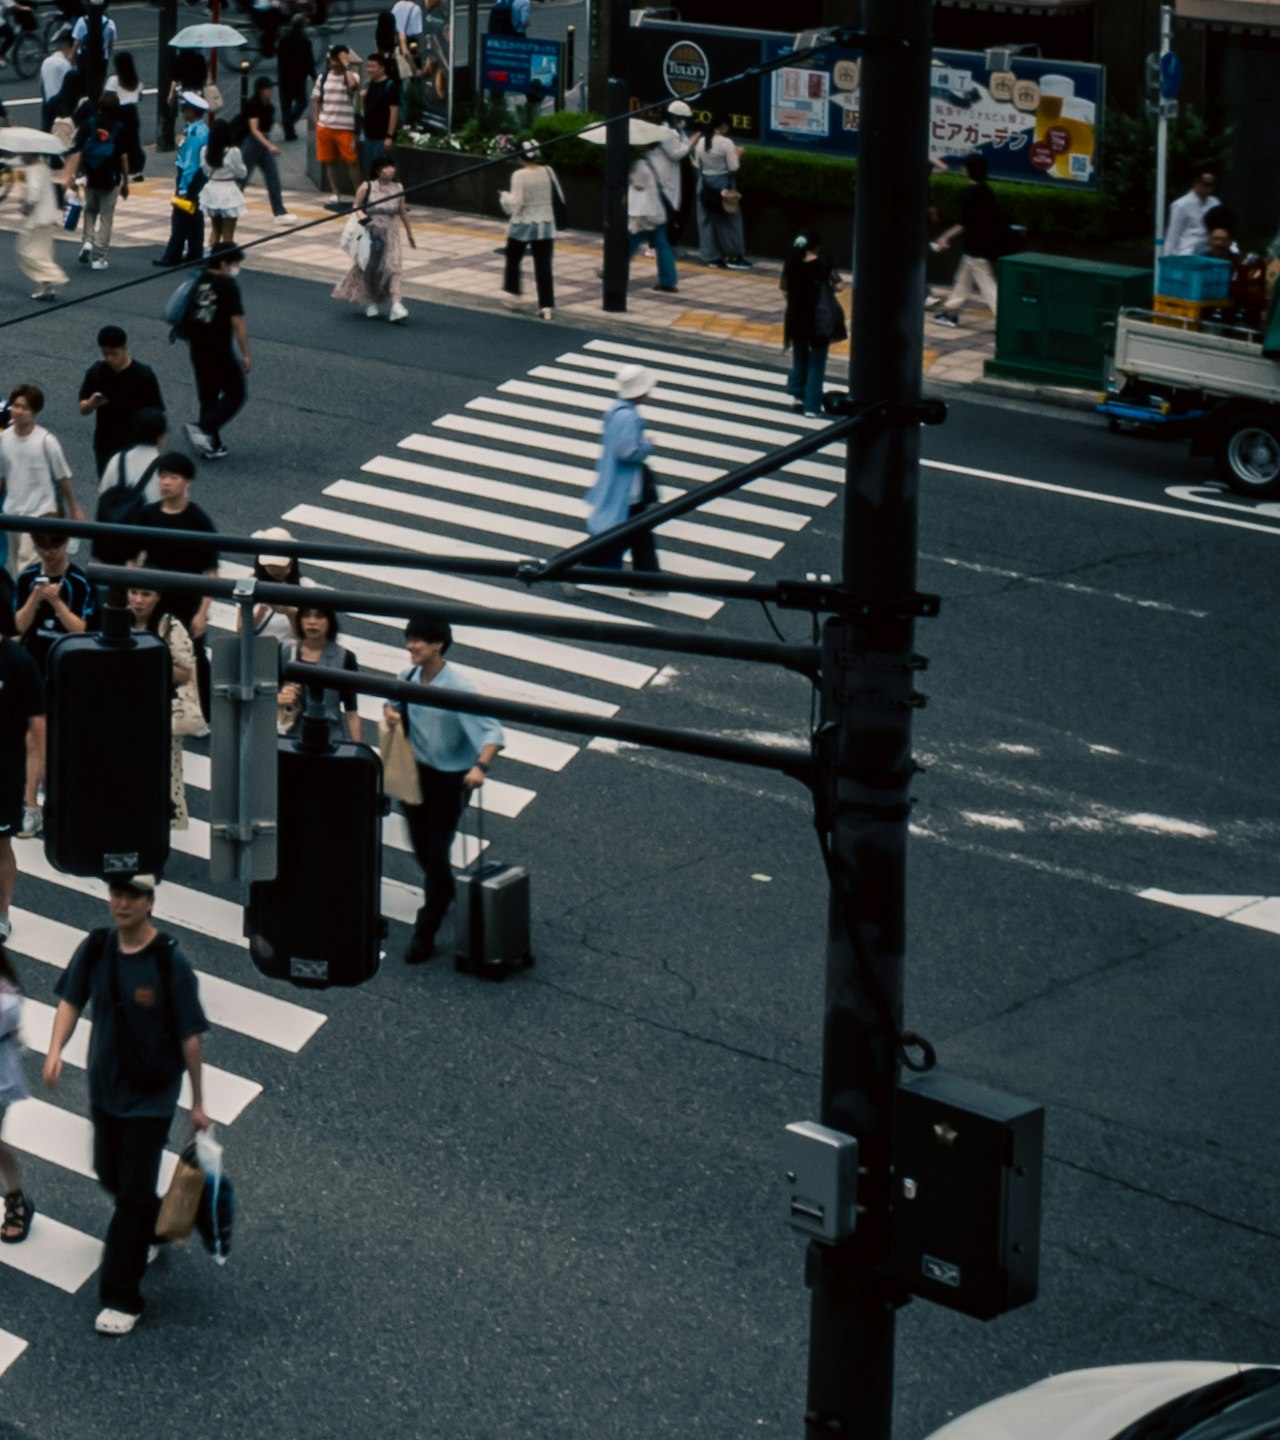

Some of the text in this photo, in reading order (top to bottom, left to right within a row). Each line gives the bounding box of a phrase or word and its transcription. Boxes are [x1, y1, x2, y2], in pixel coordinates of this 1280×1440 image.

[931, 119, 1029, 152] ビアガーデン
